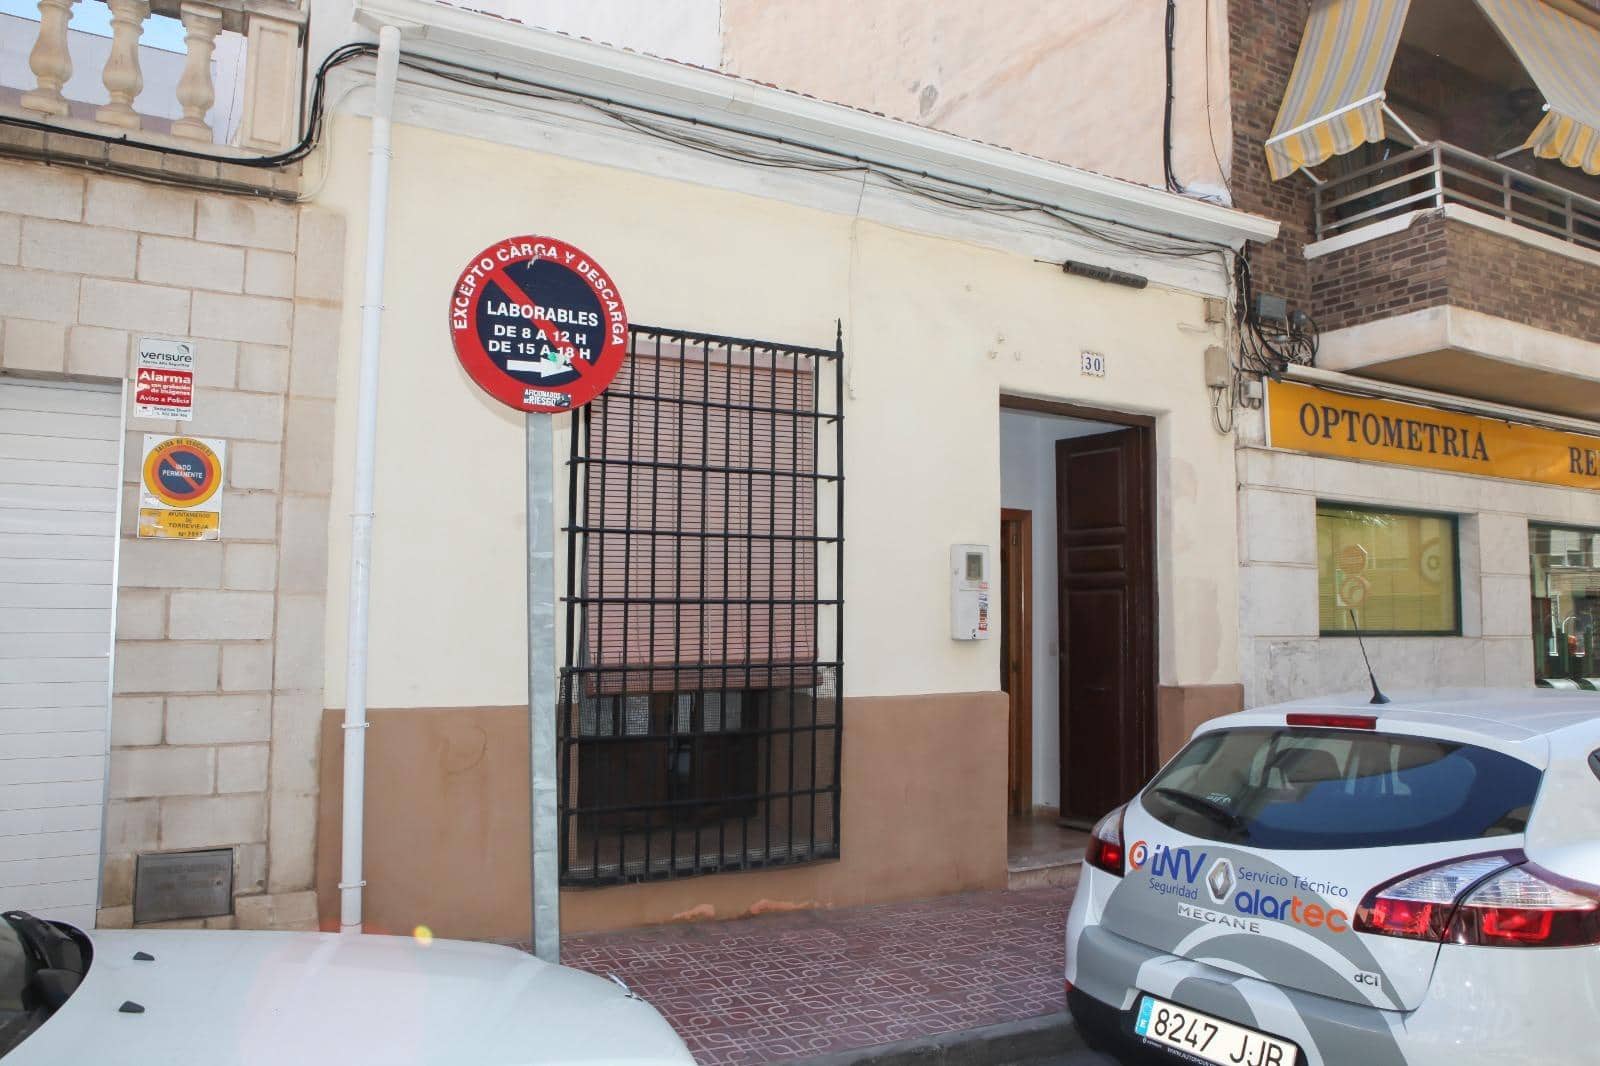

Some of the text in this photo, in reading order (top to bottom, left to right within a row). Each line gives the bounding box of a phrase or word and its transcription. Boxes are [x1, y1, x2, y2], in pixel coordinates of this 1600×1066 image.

[454, 243, 625, 346] EXCEPTO CARGA Y DESCARGA
[487, 300, 599, 327] LABORABLES
[494, 324, 587, 345] DE 8 A 12 H
[140, 351, 192, 363] verisure
[488, 340, 591, 360] DE 15 A 18 H
[1085, 356, 1101, 372] 30
[140, 370, 192, 384] Alarma
[1299, 402, 1600, 477] OPTOMETRIA RE
[162, 469, 204, 479] PERMANENTE
[1150, 878, 1198, 900] Seguridad
[1238, 867, 1348, 898] Servicio Técnico
[1178, 904, 1260, 934] MEGANE
[1235, 889, 1348, 934] alartec
[1354, 972, 1379, 988] dCi
[1154, 1008, 1218, 1052] 8247
